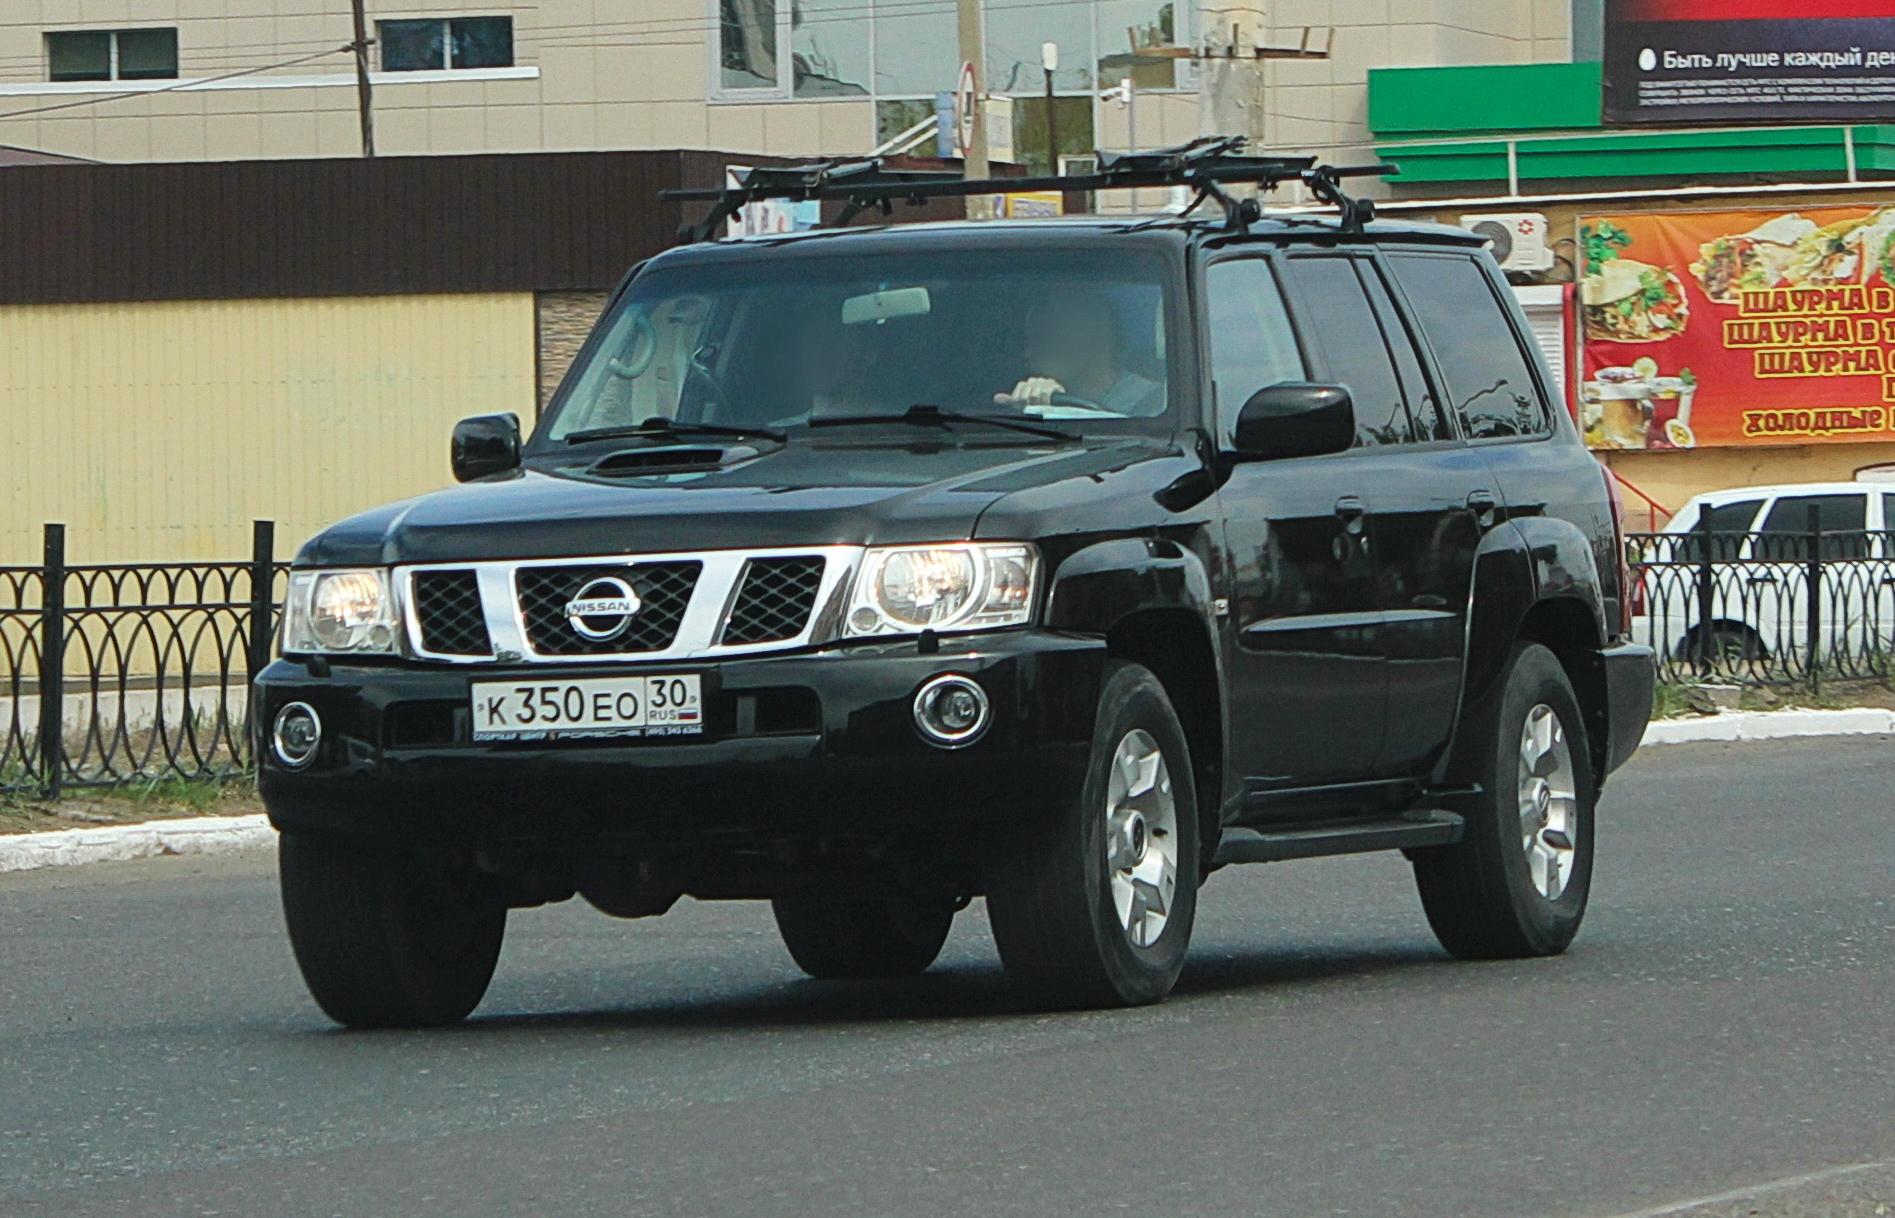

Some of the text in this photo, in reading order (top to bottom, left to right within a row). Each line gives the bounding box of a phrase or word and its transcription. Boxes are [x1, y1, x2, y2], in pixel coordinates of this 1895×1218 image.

[1663, 50, 1713, 69] Быть
[1716, 50, 1780, 71] лучше
[1784, 46, 1862, 69] каждый
[1742, 287, 1893, 314] ШАУРМА В
[1725, 319, 1851, 346] ШАУРМА
[1859, 321, 1878, 342] В
[1756, 349, 1883, 376] ШАУРМА
[571, 601, 631, 613] NISSAN
[650, 679, 687, 707] 30
[649, 709, 676, 721] RUS
